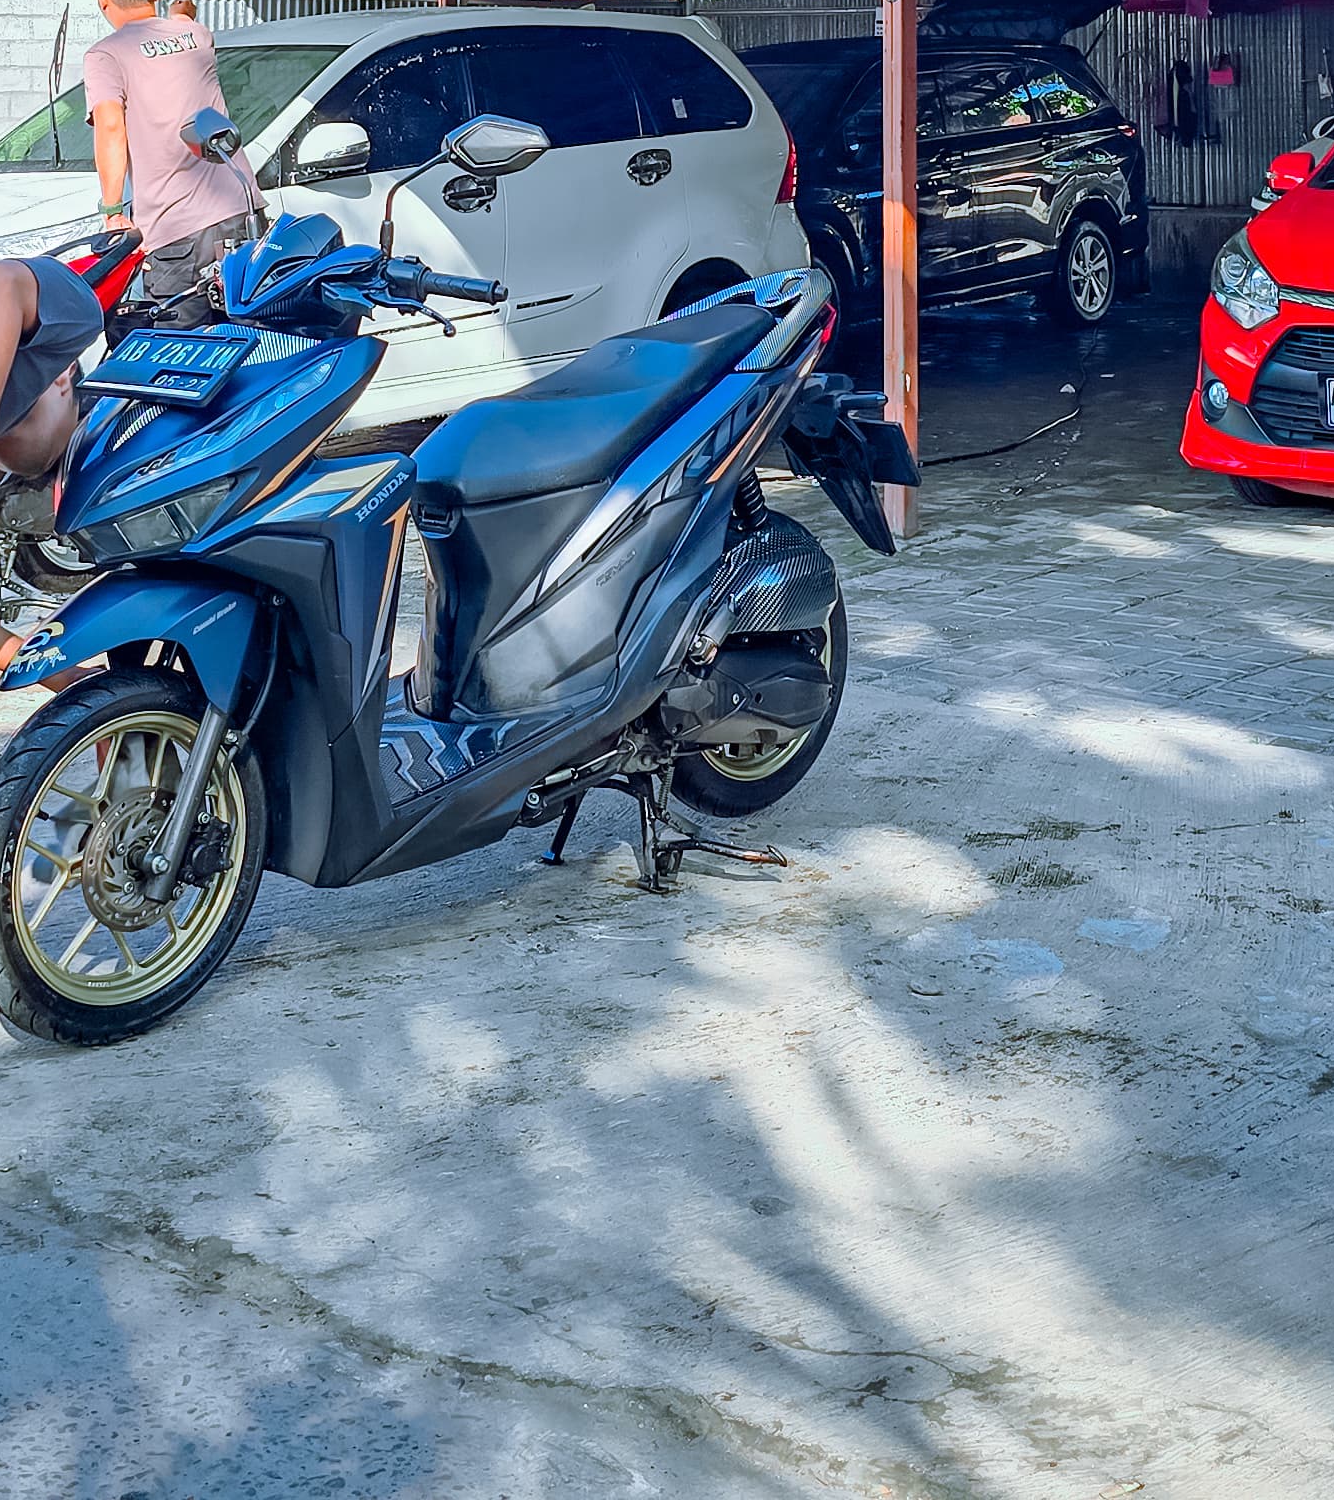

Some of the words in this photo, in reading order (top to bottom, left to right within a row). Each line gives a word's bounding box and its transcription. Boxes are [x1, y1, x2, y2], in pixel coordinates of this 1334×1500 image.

[120, 340, 150, 361] AB
[150, 342, 206, 366] 4261
[200, 345, 238, 370] XM
[355, 471, 409, 523] HONDA
